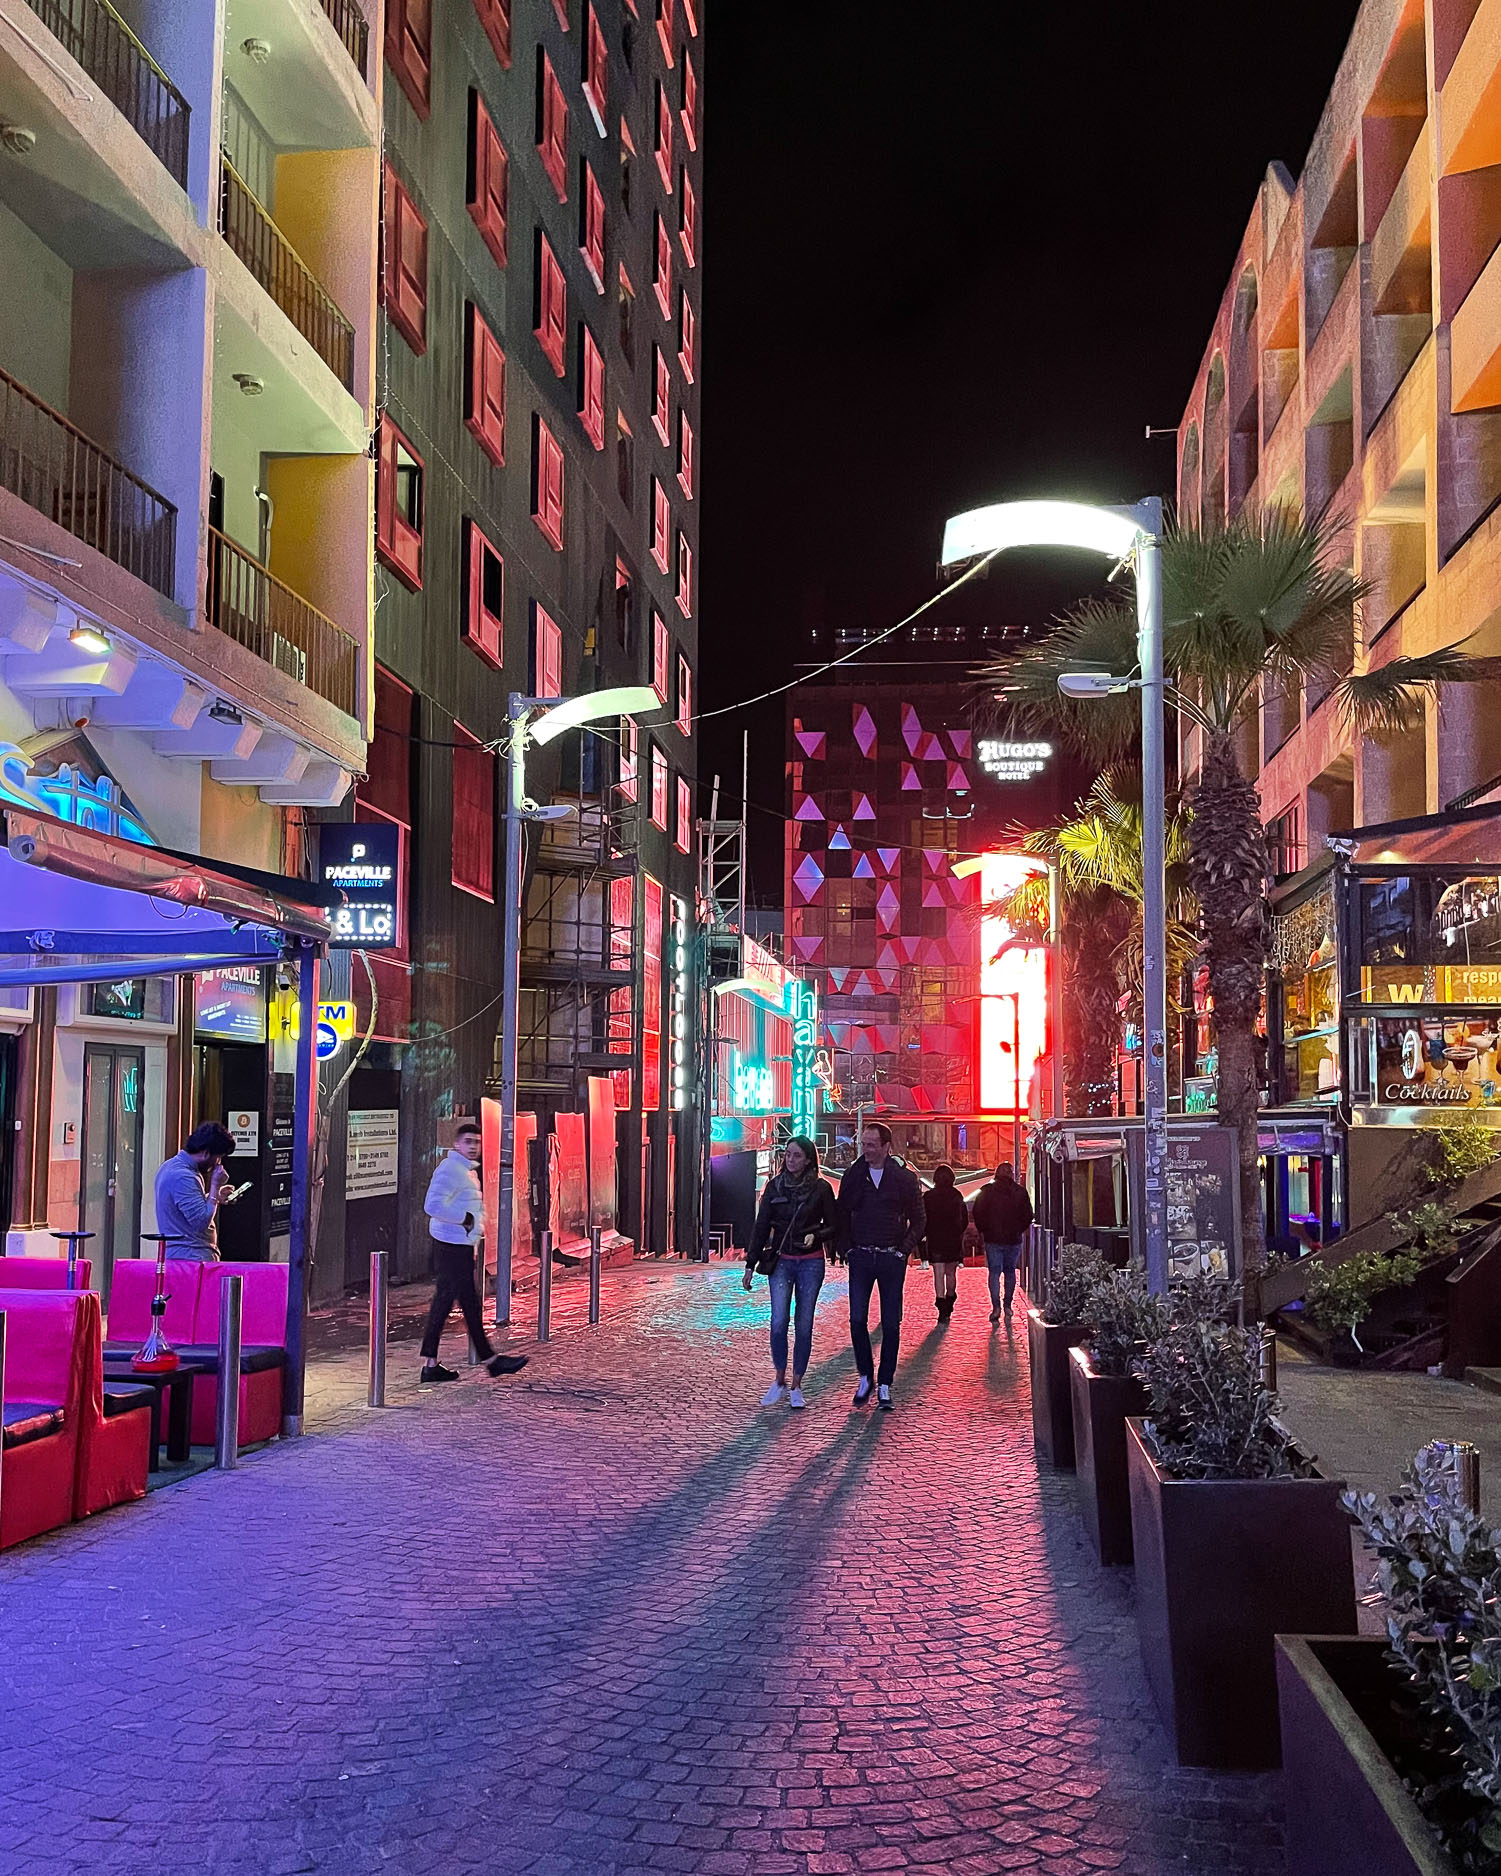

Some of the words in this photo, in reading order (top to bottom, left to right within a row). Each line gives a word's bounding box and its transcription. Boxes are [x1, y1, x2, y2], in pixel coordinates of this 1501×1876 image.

[977, 740, 1053, 761] HUGO'S
[984, 760, 1044, 772] BOUTIQUE
[998, 771, 1030, 780] HOTEL
[325, 866, 391, 880] PACEVILLE
[333, 880, 383, 888] APARTMENTS
[336, 910, 354, 934] &
[1463, 971, 1501, 987] resp
[221, 981, 256, 996] APARTMENTS
[794, 979, 816, 1143] havana
[1385, 1083, 1470, 1101] Cocktails
